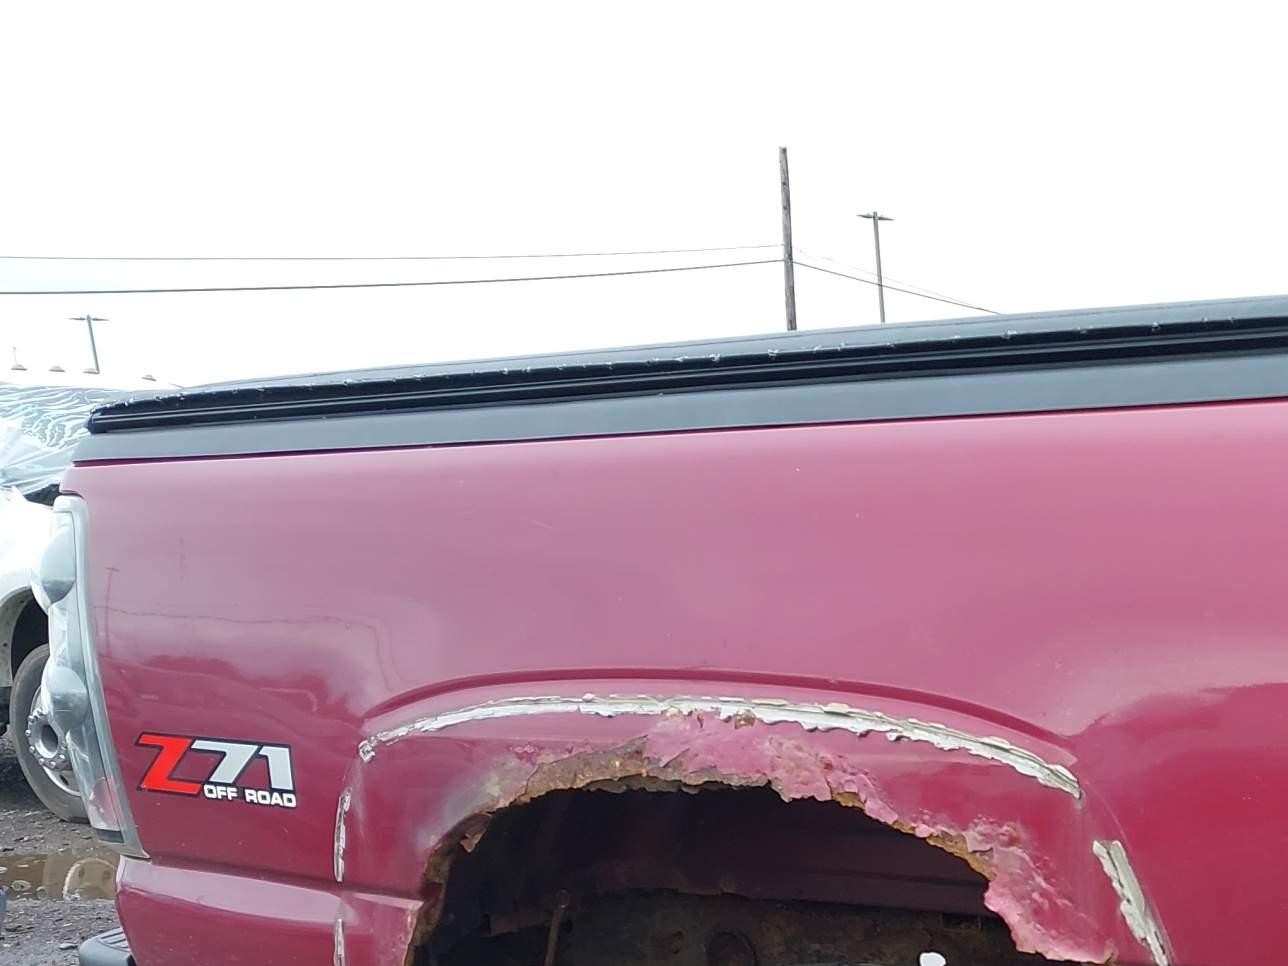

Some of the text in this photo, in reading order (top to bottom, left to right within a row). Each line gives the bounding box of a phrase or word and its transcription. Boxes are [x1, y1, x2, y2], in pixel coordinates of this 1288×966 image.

[136, 733, 295, 796] Z71
[203, 783, 297, 808] OFF ROAD
